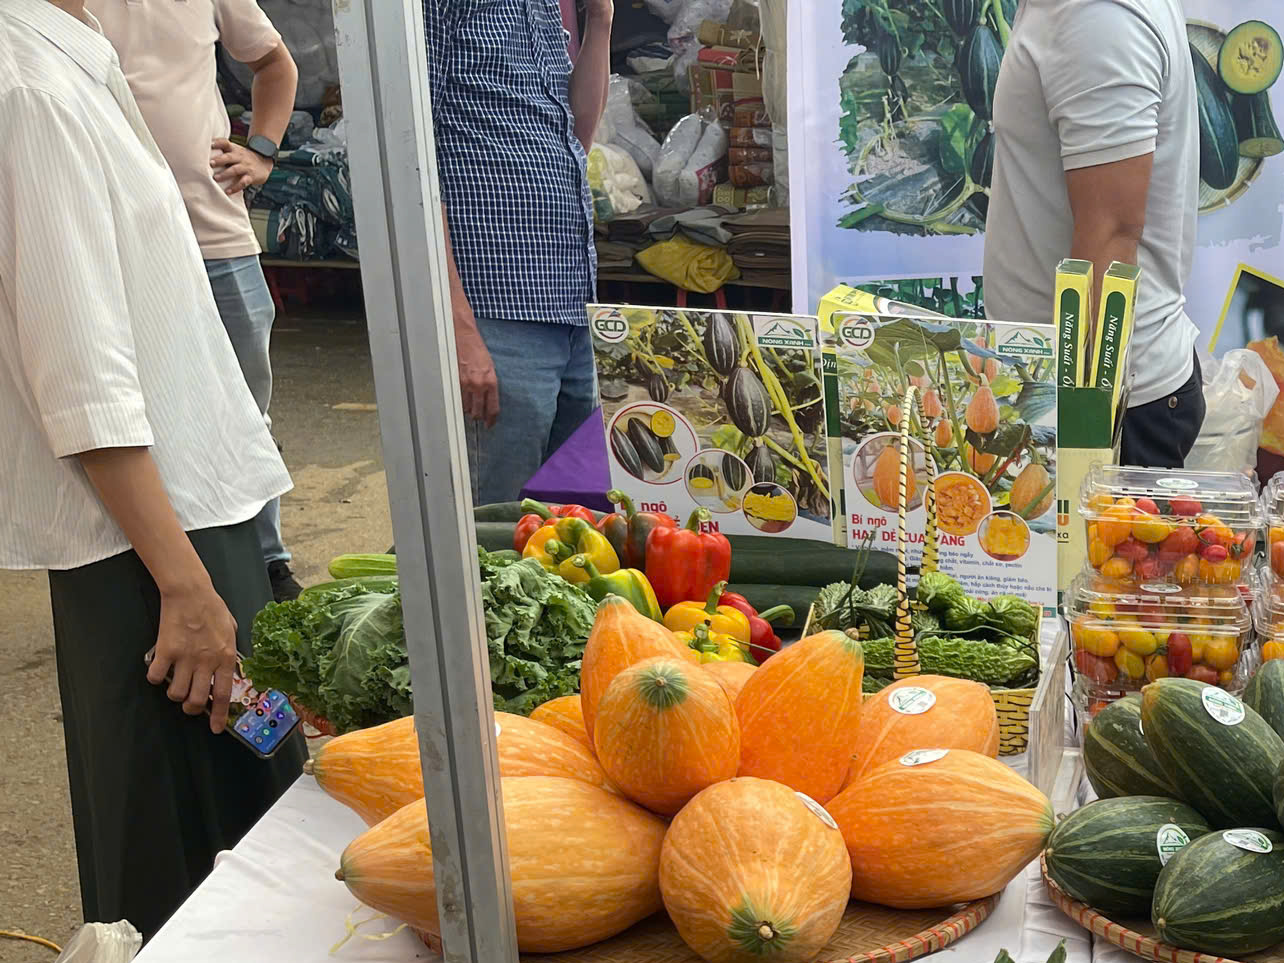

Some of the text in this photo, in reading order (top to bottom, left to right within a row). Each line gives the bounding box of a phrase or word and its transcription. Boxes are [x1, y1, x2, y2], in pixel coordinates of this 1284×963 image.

[595, 319, 627, 332] GCD
[842, 326, 872, 339] GCD
[1062, 312, 1075, 339] Năng
[1105, 315, 1118, 342] Năng
